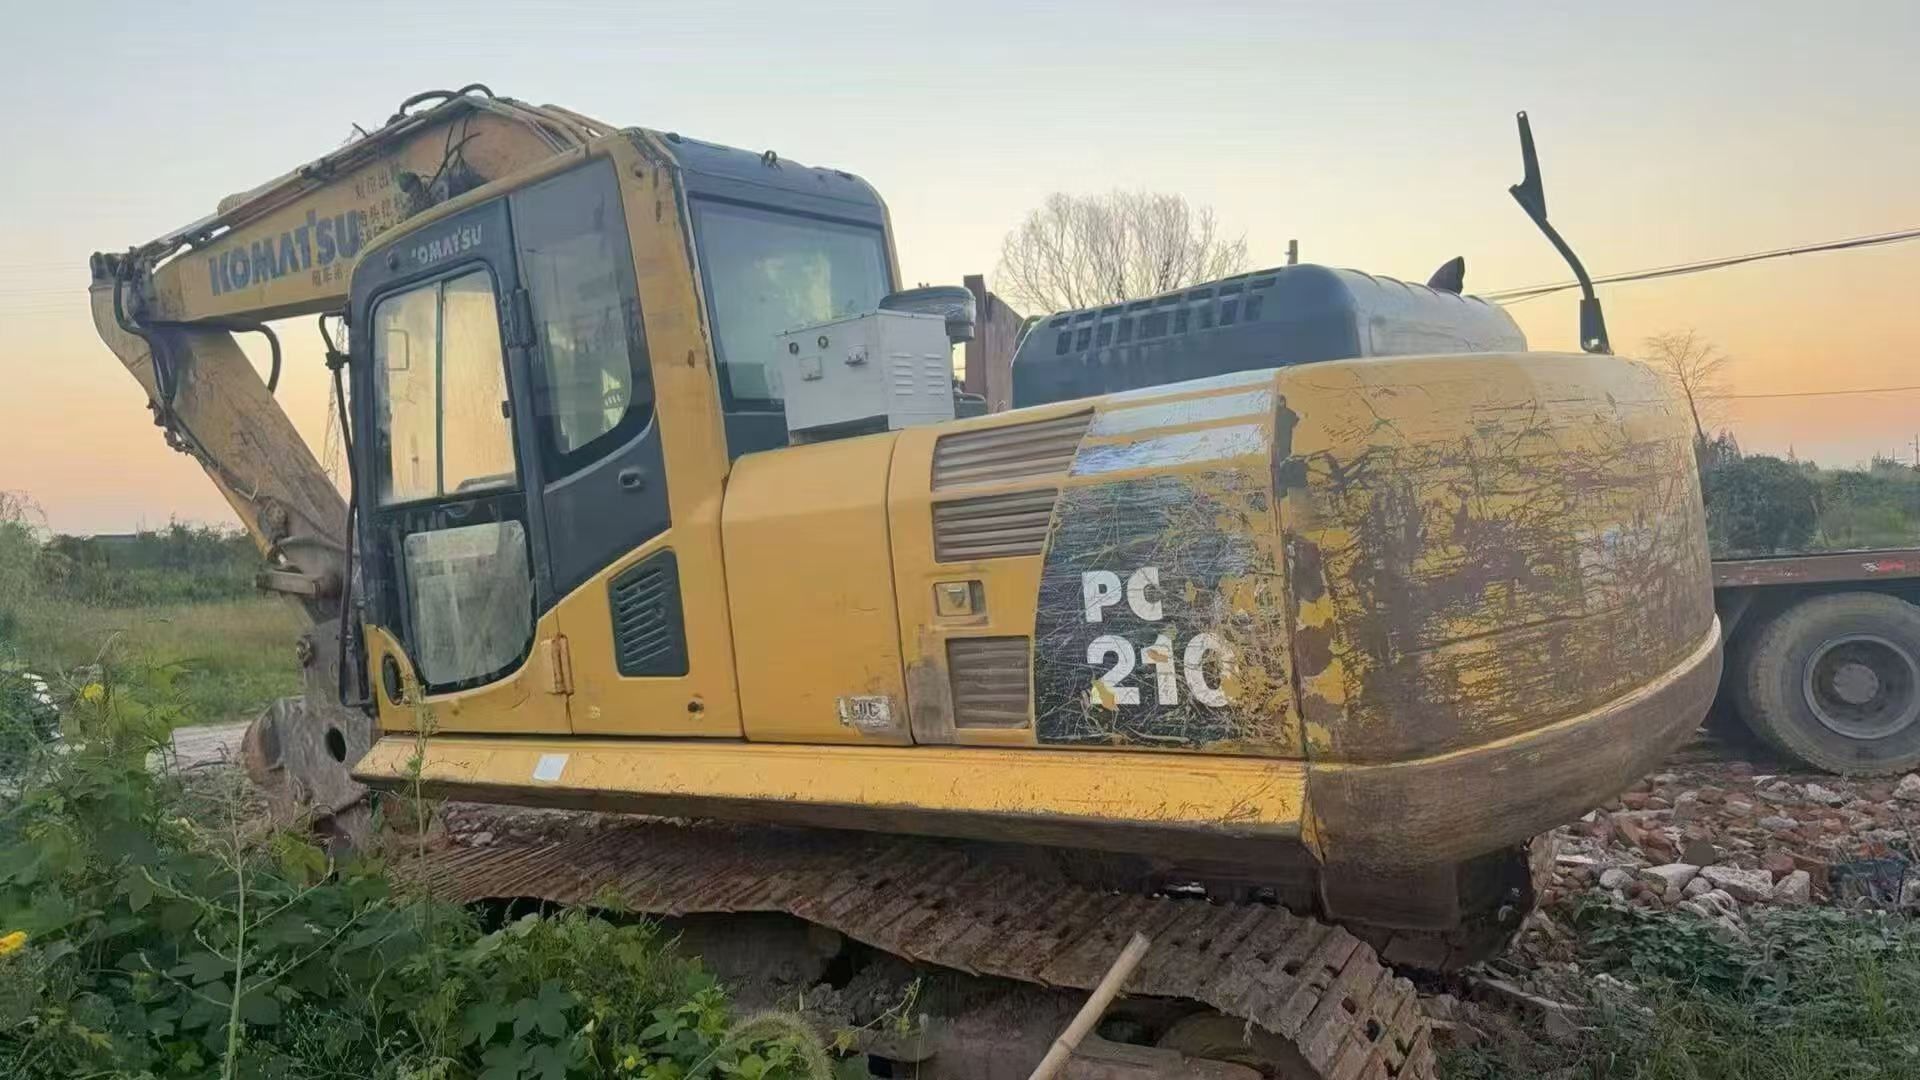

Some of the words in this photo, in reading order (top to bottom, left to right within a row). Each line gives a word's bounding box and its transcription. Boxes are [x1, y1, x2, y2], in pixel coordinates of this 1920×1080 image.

[208, 209, 361, 296] KOMATSU
[411, 224, 482, 265] OMATSU
[1082, 566, 1163, 622] PC
[1086, 632, 1240, 708] 210
